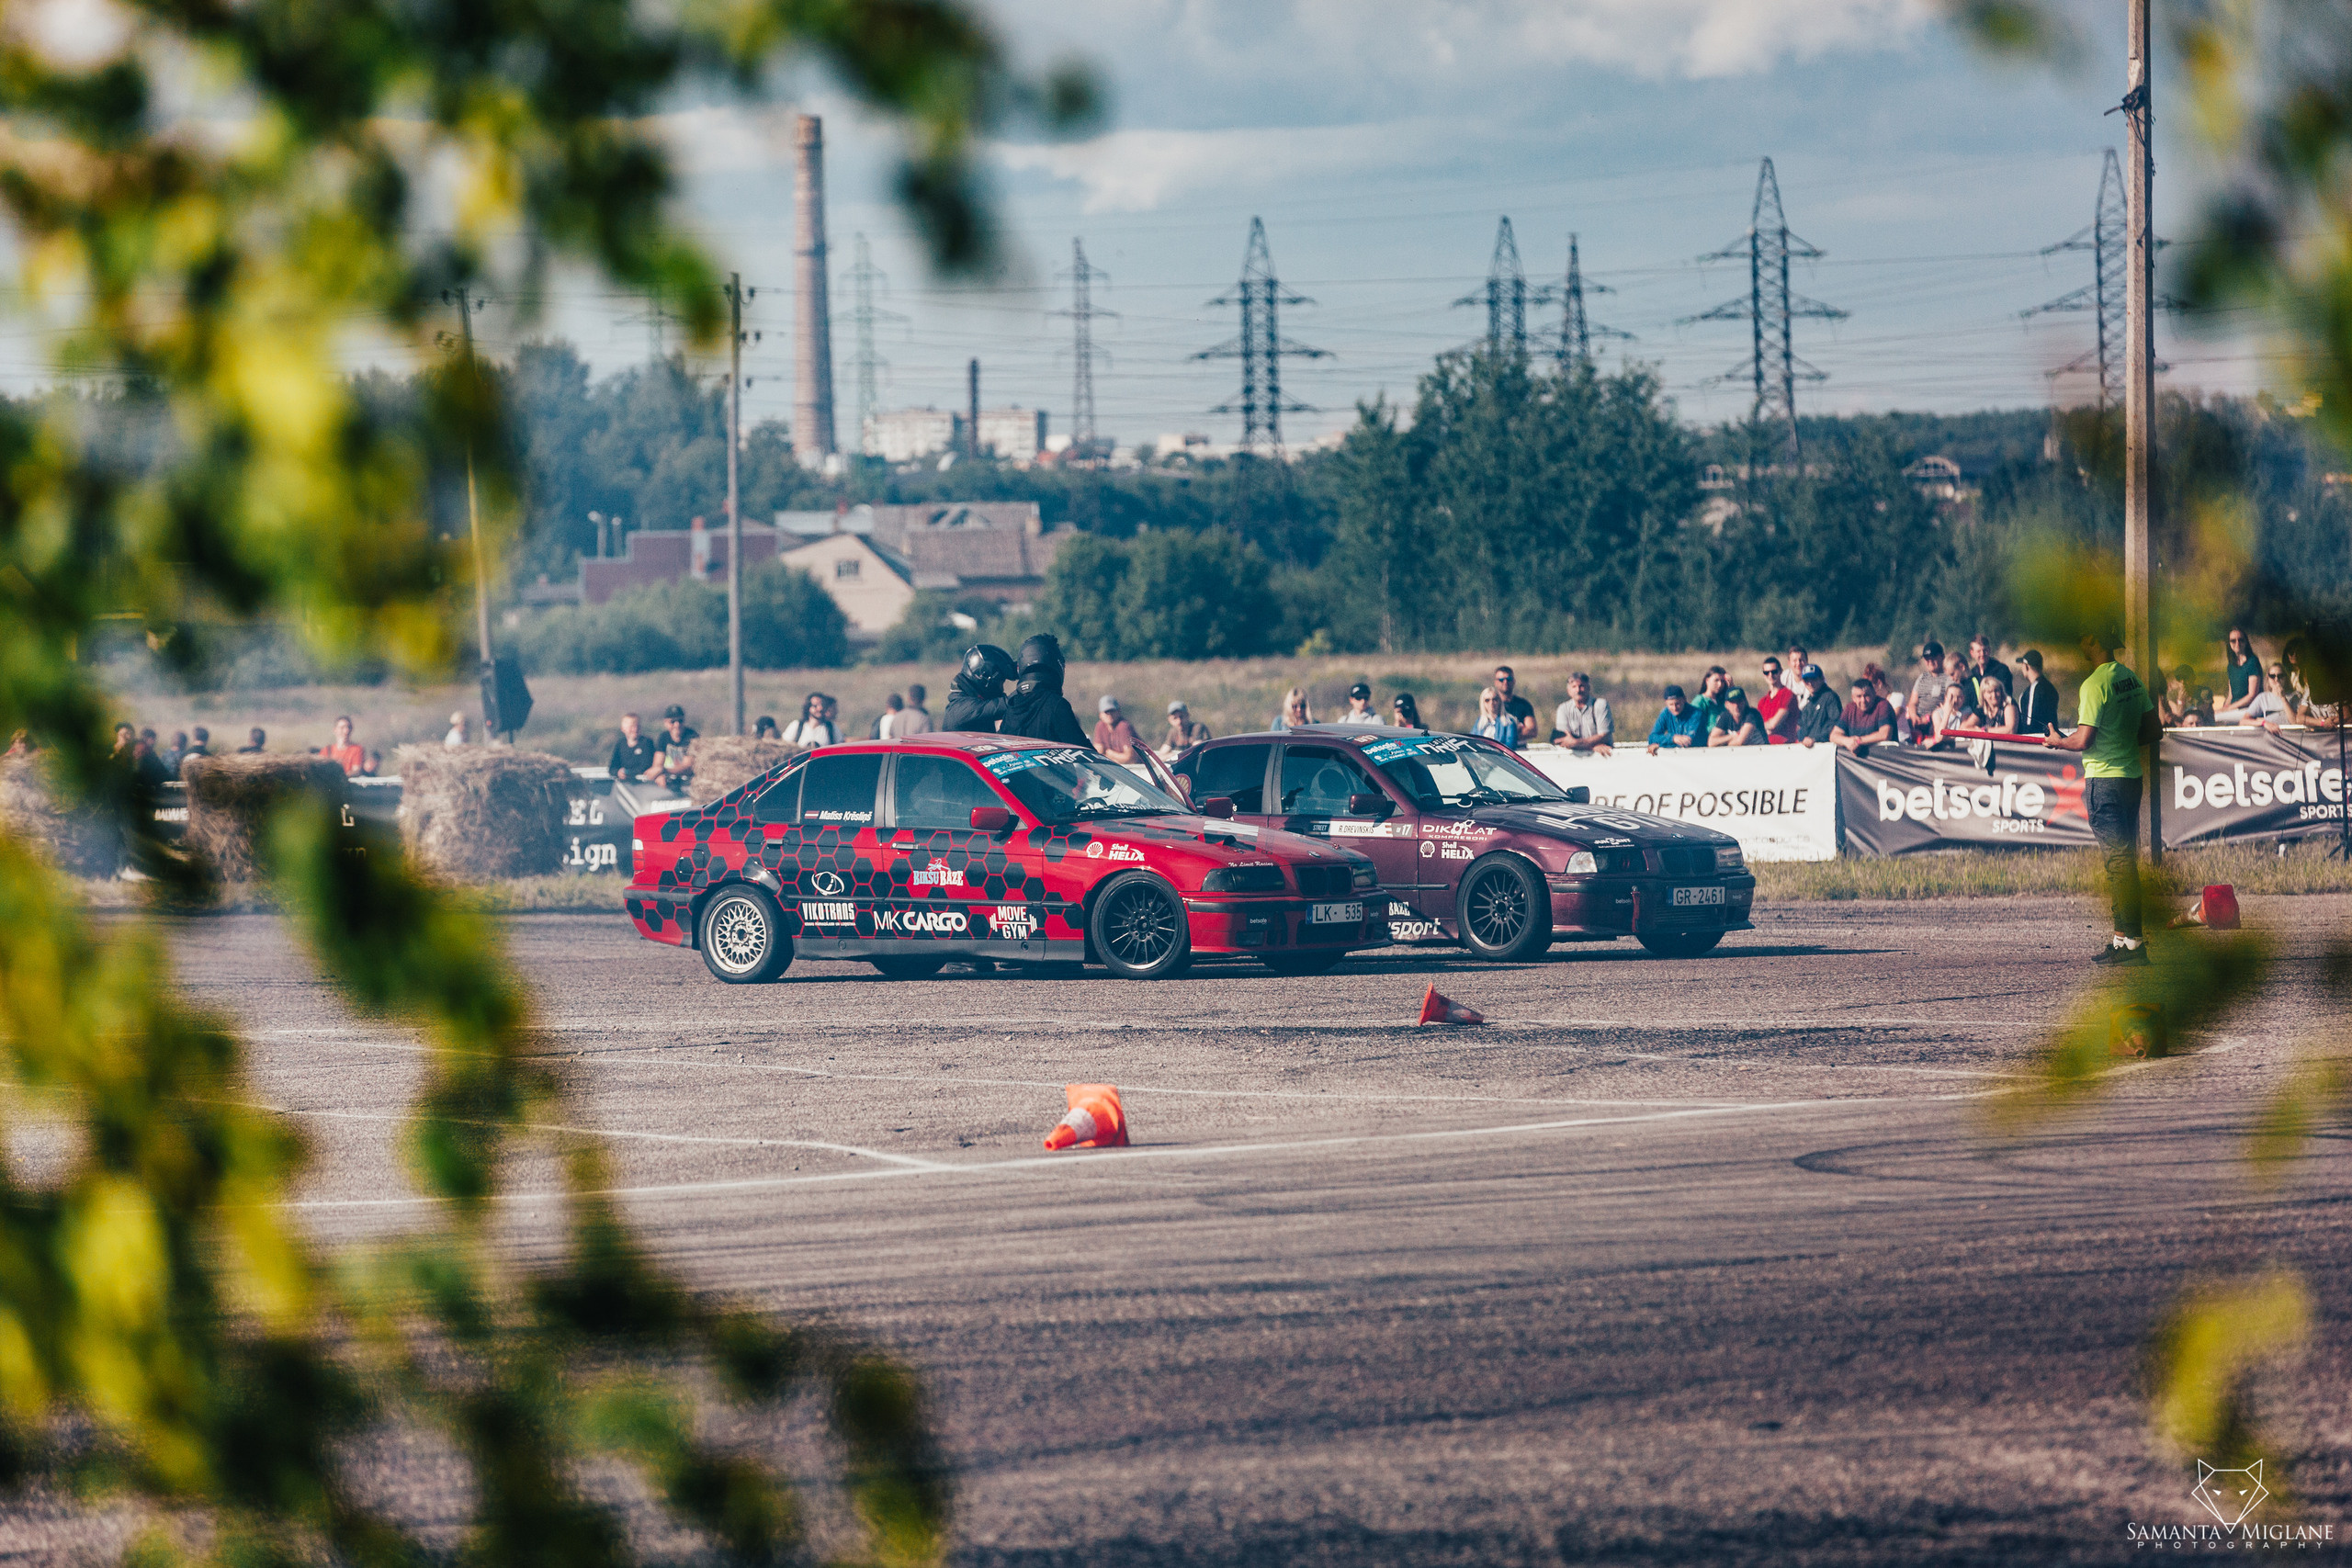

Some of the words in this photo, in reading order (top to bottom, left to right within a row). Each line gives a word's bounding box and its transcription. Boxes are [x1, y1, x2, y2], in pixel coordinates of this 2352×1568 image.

[2174, 760, 2350, 809] betsafe
[1634, 794, 1672, 816] OF
[1679, 788, 1808, 818] POSSIBLE
[1877, 773, 2045, 822] betsafe
[1312, 824, 1328, 832] STREET
[1992, 818, 2045, 834] SPORTS
[563, 837, 618, 872] ign
[1108, 849, 1145, 862] HELIX
[1110, 842, 1129, 852] Shell
[1441, 845, 1475, 860] HELIX
[1676, 888, 1724, 905] GR-2461
[802, 902, 854, 920] VIKOTRANS
[997, 905, 1028, 921] MOVE
[874, 911, 902, 931] MK
[902, 911, 967, 932] CARGO
[1387, 918, 1442, 940] sport
[1001, 924, 1028, 940] GYM
